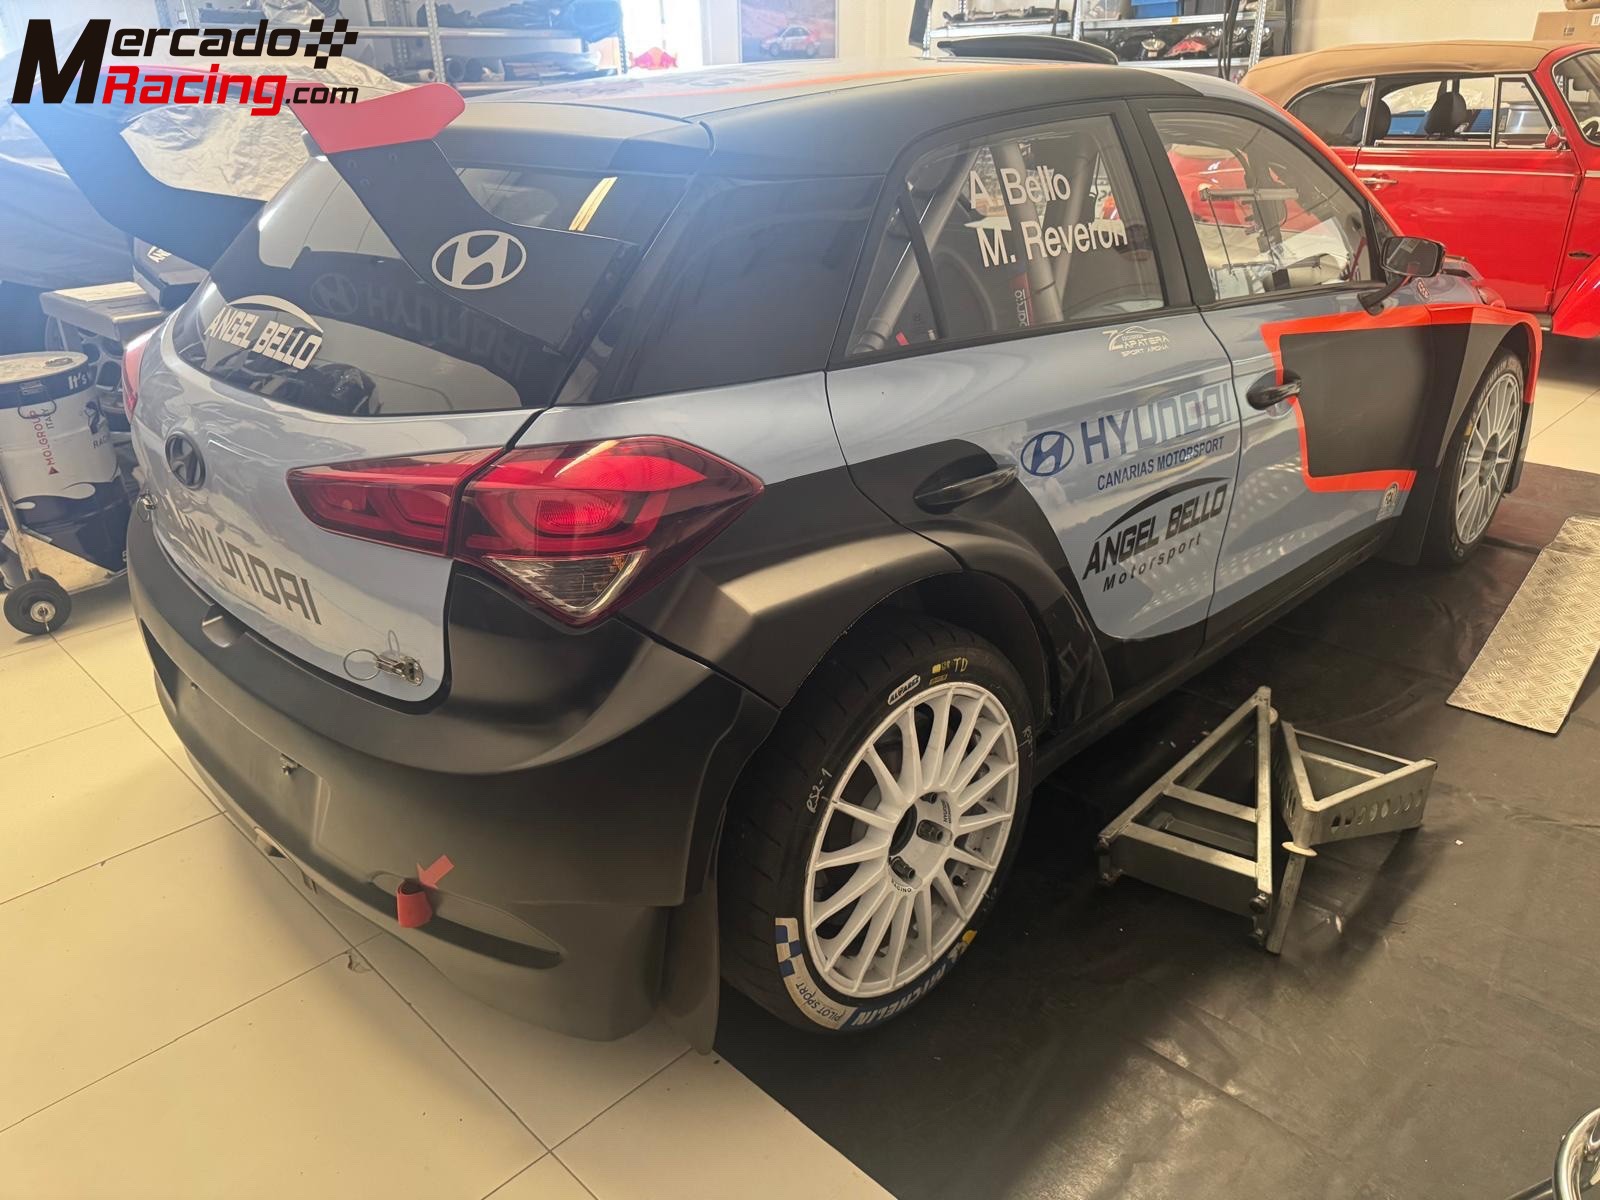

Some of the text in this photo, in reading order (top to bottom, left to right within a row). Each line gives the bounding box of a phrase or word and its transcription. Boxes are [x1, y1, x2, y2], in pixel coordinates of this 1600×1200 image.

[1000, 165, 1071, 205] Bello
[976, 221, 1128, 267] M. Reveron
[204, 307, 323, 370] ANGEL BELLO
[68, 373, 88, 390] It's
[1080, 383, 1232, 465] HYUNDAI
[1097, 436, 1225, 491] CANARIAS MOTORSPORT
[1082, 483, 1228, 580] ANGEL BELLO
[177, 508, 322, 626] HYUNDAI
[1102, 533, 1202, 592] Motorsport
[795, 982, 845, 1023] PILOT SPORT
